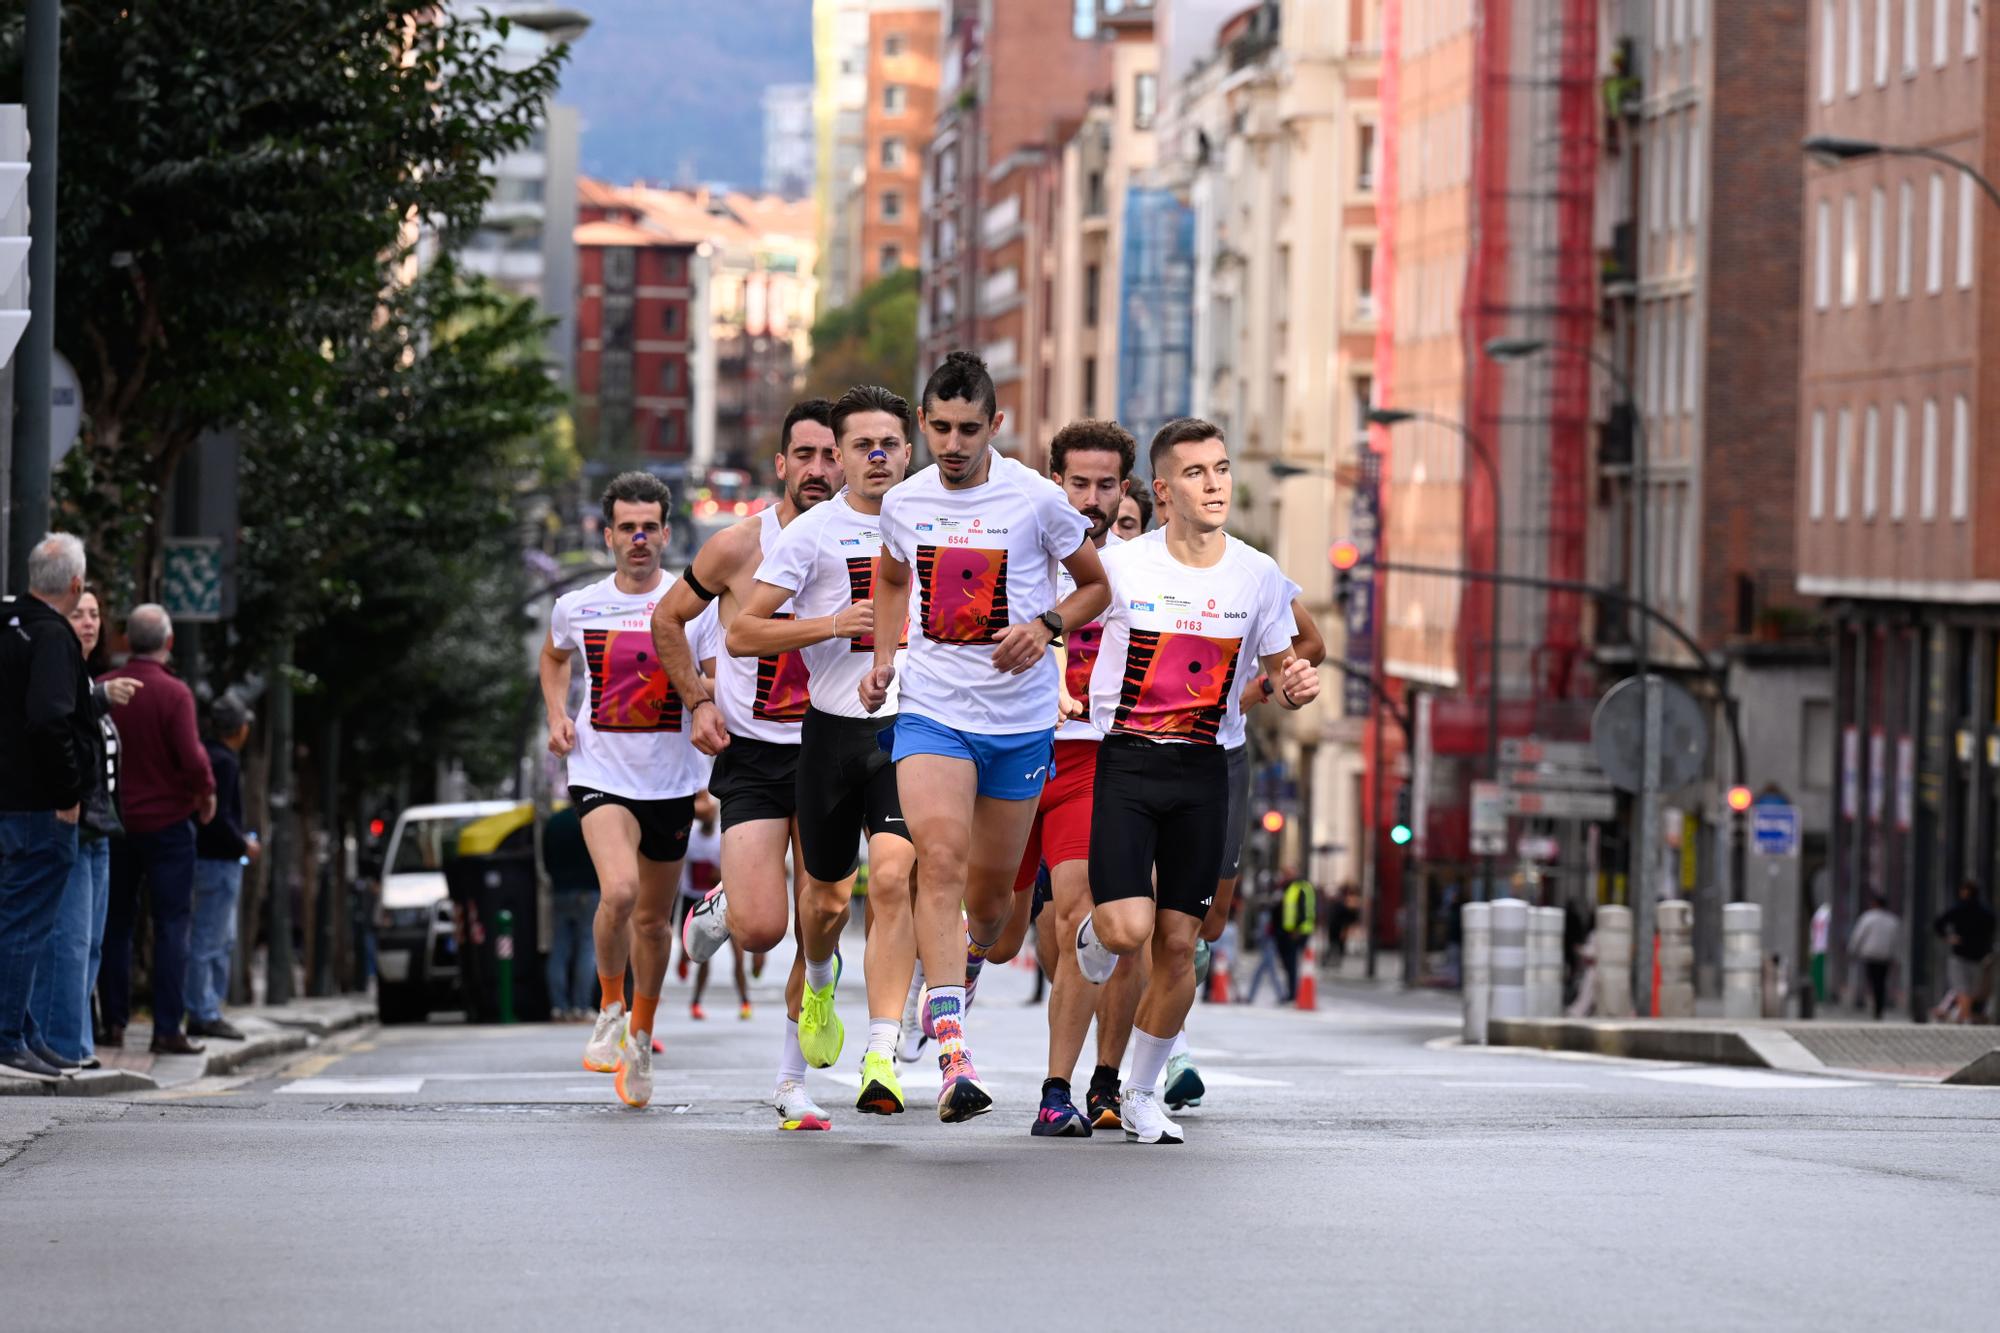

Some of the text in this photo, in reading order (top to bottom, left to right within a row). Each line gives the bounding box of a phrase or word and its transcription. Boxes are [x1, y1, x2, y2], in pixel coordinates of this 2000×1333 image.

[948, 535, 969, 544] 6544
[1201, 611, 1220, 619] Bilbao
[622, 620, 644, 628] 1199
[1175, 619, 1202, 631] 0163
